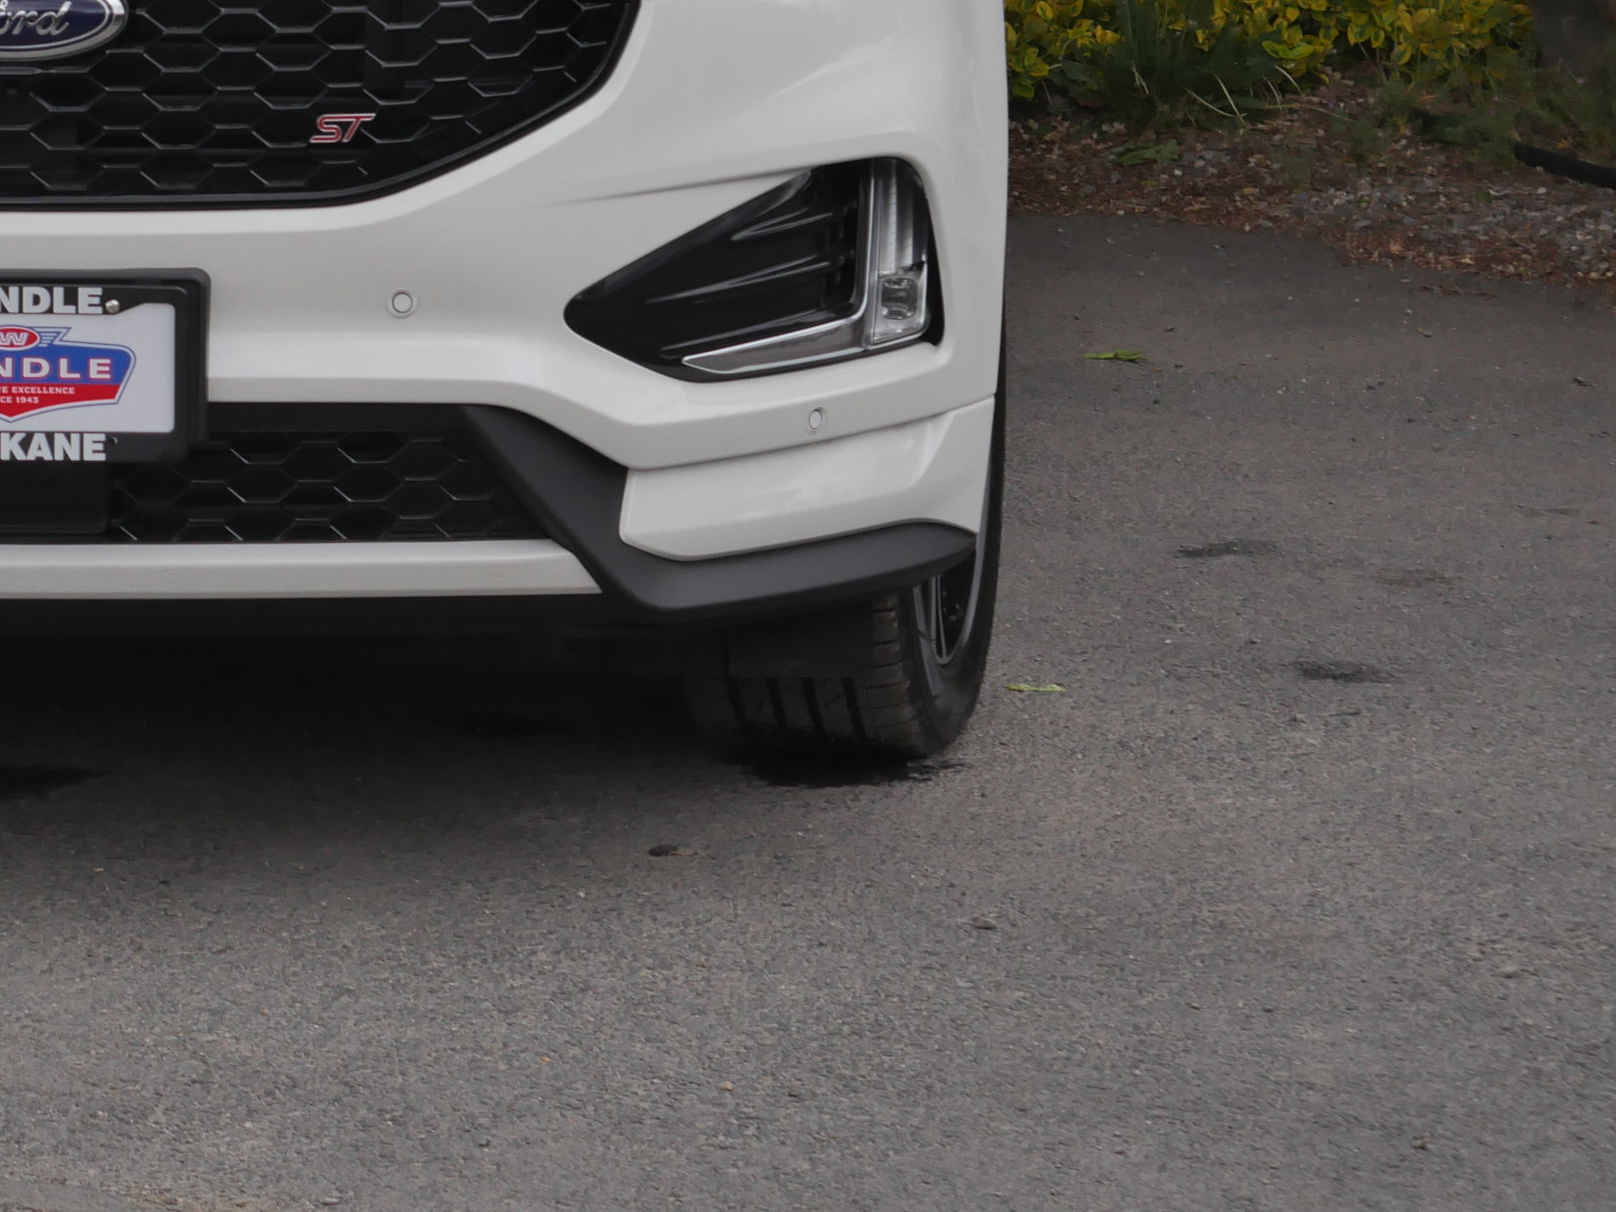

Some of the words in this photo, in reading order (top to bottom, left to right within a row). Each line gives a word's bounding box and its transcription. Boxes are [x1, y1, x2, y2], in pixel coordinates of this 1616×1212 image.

[309, 113, 376, 143] ST
[11, 386, 76, 395] EXCELLENCE
[15, 396, 39, 404] 1943
